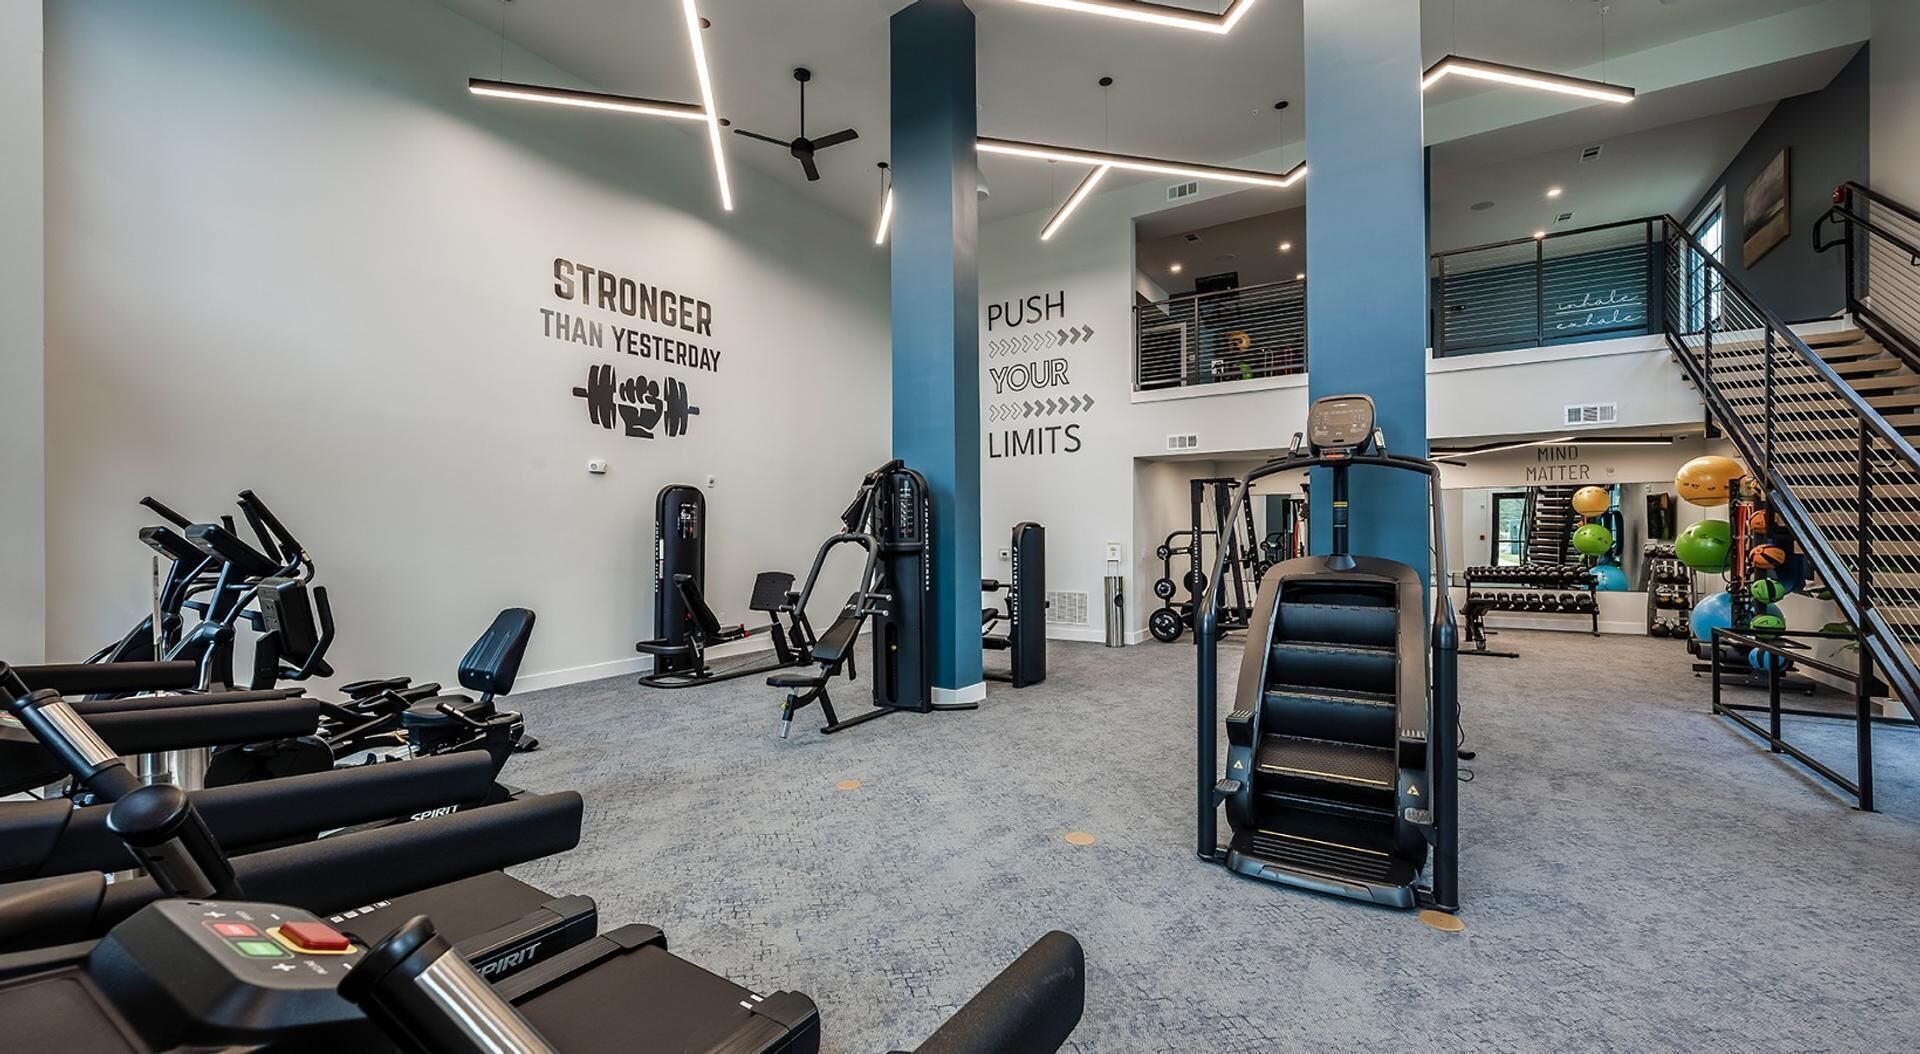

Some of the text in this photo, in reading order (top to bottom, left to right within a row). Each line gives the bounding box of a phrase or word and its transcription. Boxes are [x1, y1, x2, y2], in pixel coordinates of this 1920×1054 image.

[553, 257, 712, 337] STRONGER
[987, 290, 1065, 331] PUSH
[540, 308, 721, 373] THAN YESTERDAY
[989, 358, 1070, 394] YOUR
[989, 424, 1082, 459] LIMITS
[1537, 445, 1579, 462] MIND
[1526, 464, 1590, 482] MATTER
[410, 803, 460, 821] SPIRIT
[476, 942, 542, 977] PIRIT
